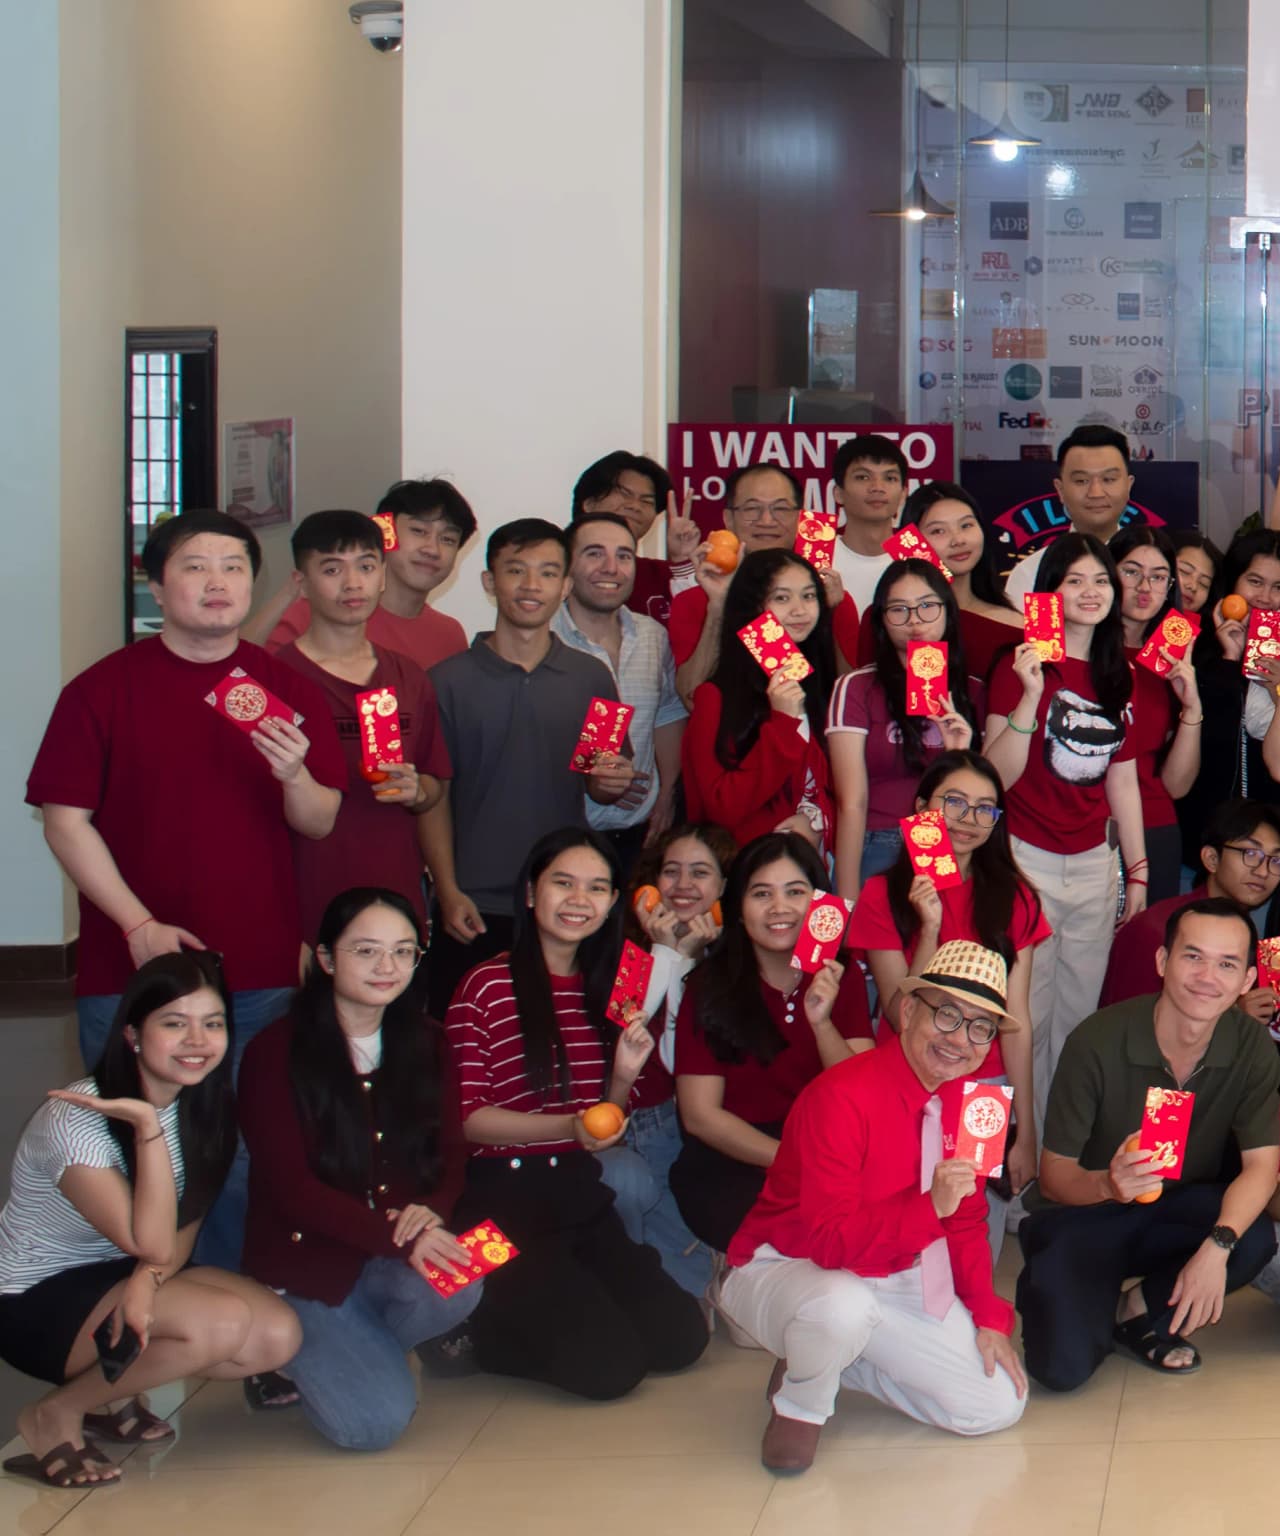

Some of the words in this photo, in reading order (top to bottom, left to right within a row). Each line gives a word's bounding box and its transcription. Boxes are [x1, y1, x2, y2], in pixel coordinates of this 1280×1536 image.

[992, 217, 1028, 232] ADB
[1069, 335, 1099, 345] SUN
[1115, 335, 1163, 346] MOON
[999, 412, 1052, 429] FedEx
[683, 432, 694, 468] I
